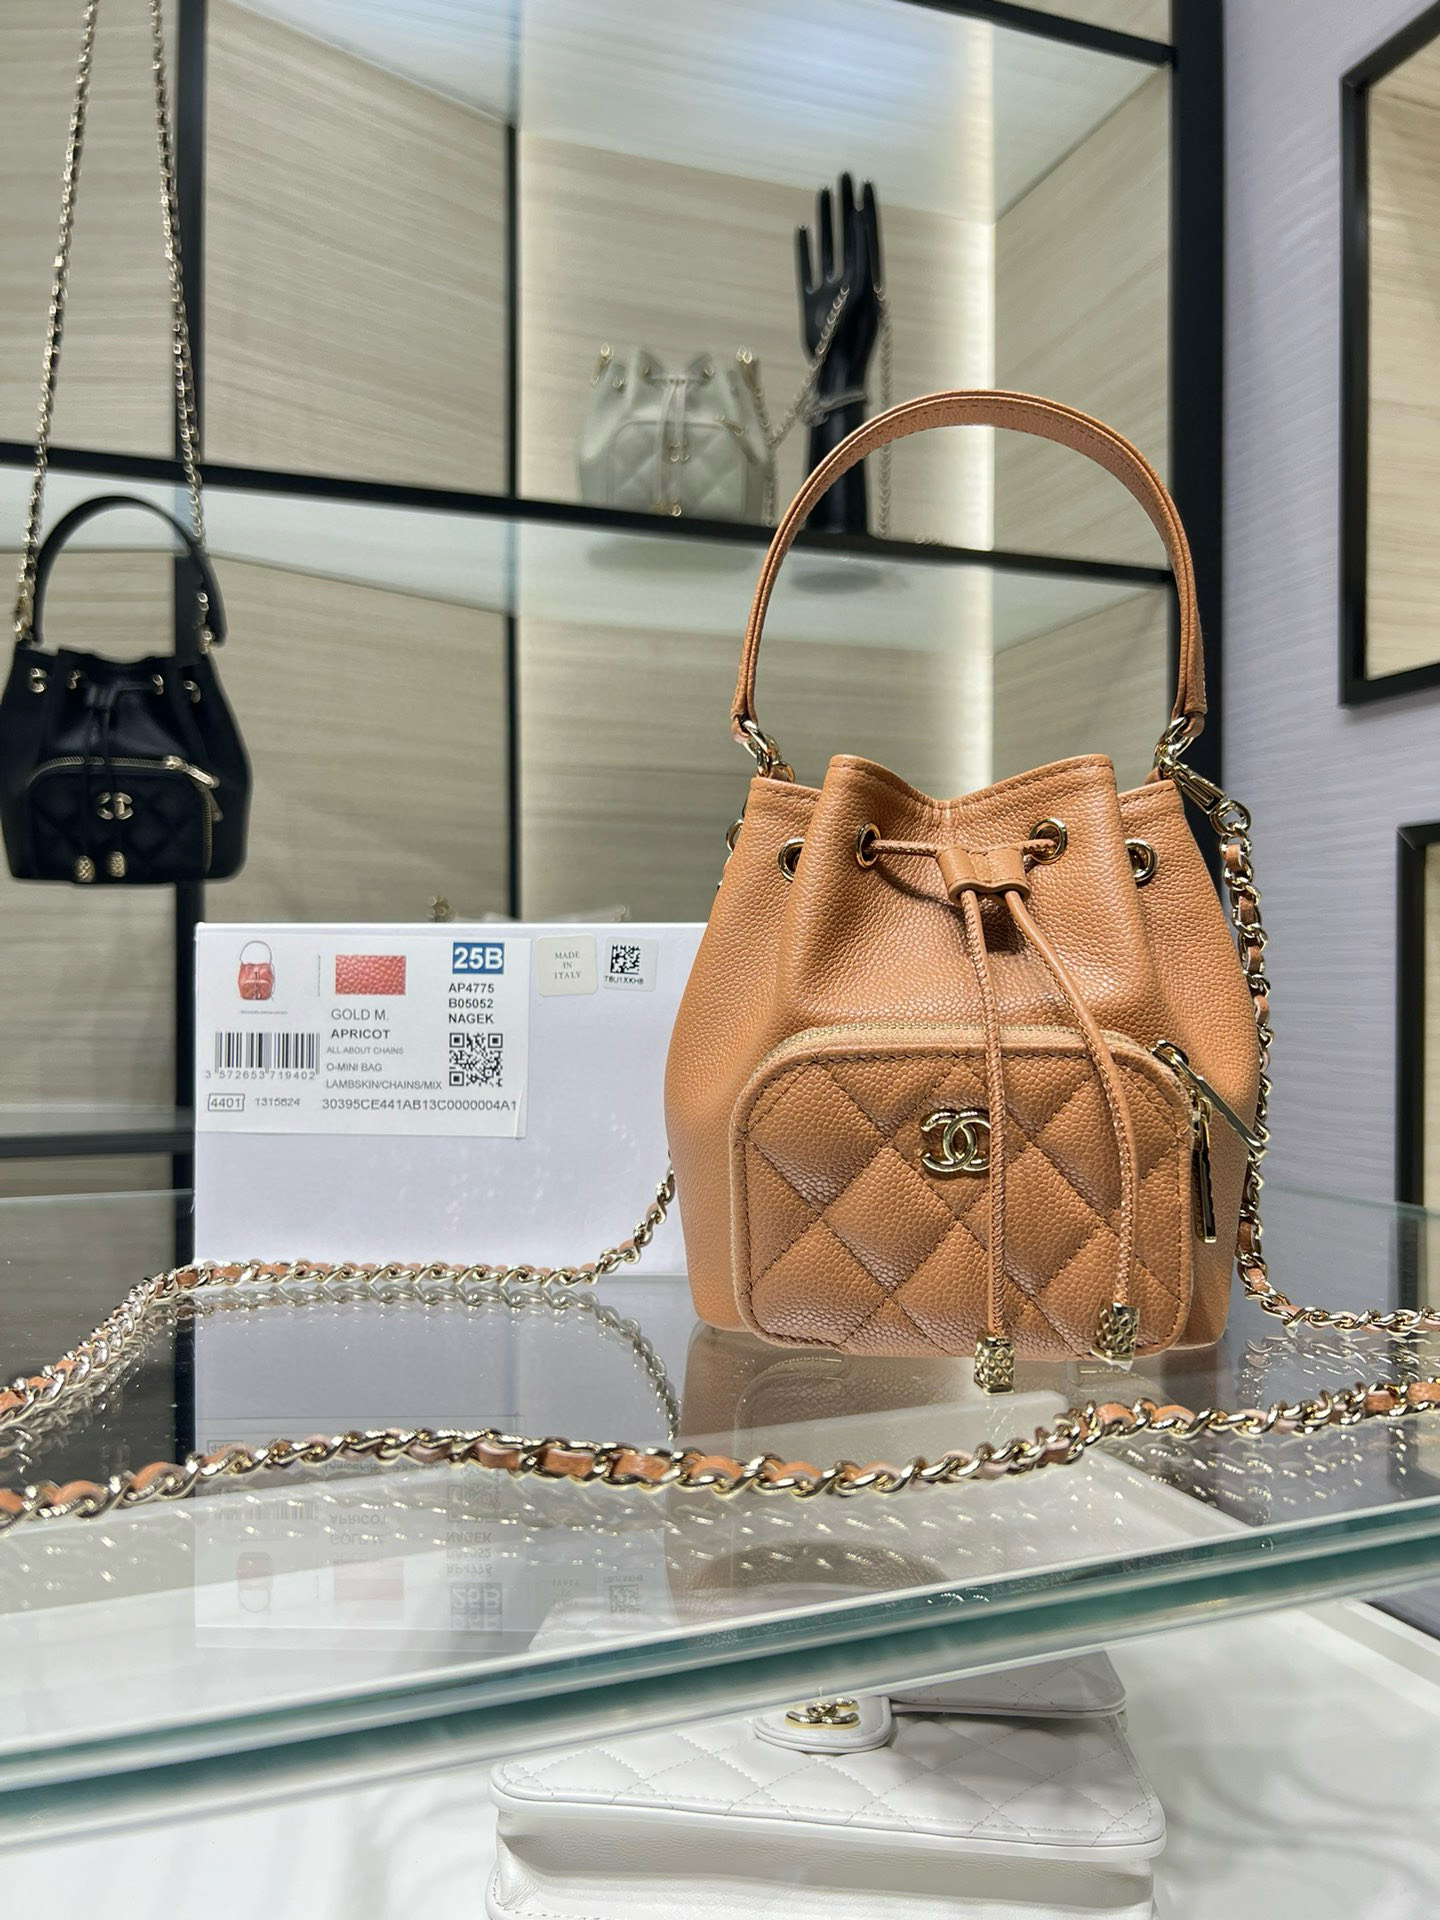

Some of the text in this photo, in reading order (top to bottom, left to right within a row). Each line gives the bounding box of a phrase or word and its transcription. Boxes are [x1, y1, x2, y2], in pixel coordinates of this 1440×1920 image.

[453, 947, 503, 970] 25B
[555, 951, 581, 960] MADE
[563, 961, 573, 969] IN
[554, 970, 582, 980] ITALY
[448, 983, 495, 994] AP4775
[448, 998, 495, 1009] B05052
[331, 1008, 389, 1021] GOLD M.
[448, 1013, 495, 1025] NAGEK
[331, 1028, 391, 1040] APRICOT
[327, 1047, 404, 1055] ALL ABOUT CHAINS
[326, 1062, 383, 1073] O-MINI BAG
[326, 1079, 443, 1091] LAMBSKIN/CHAINS/MIX
[211, 1097, 241, 1109] 4401
